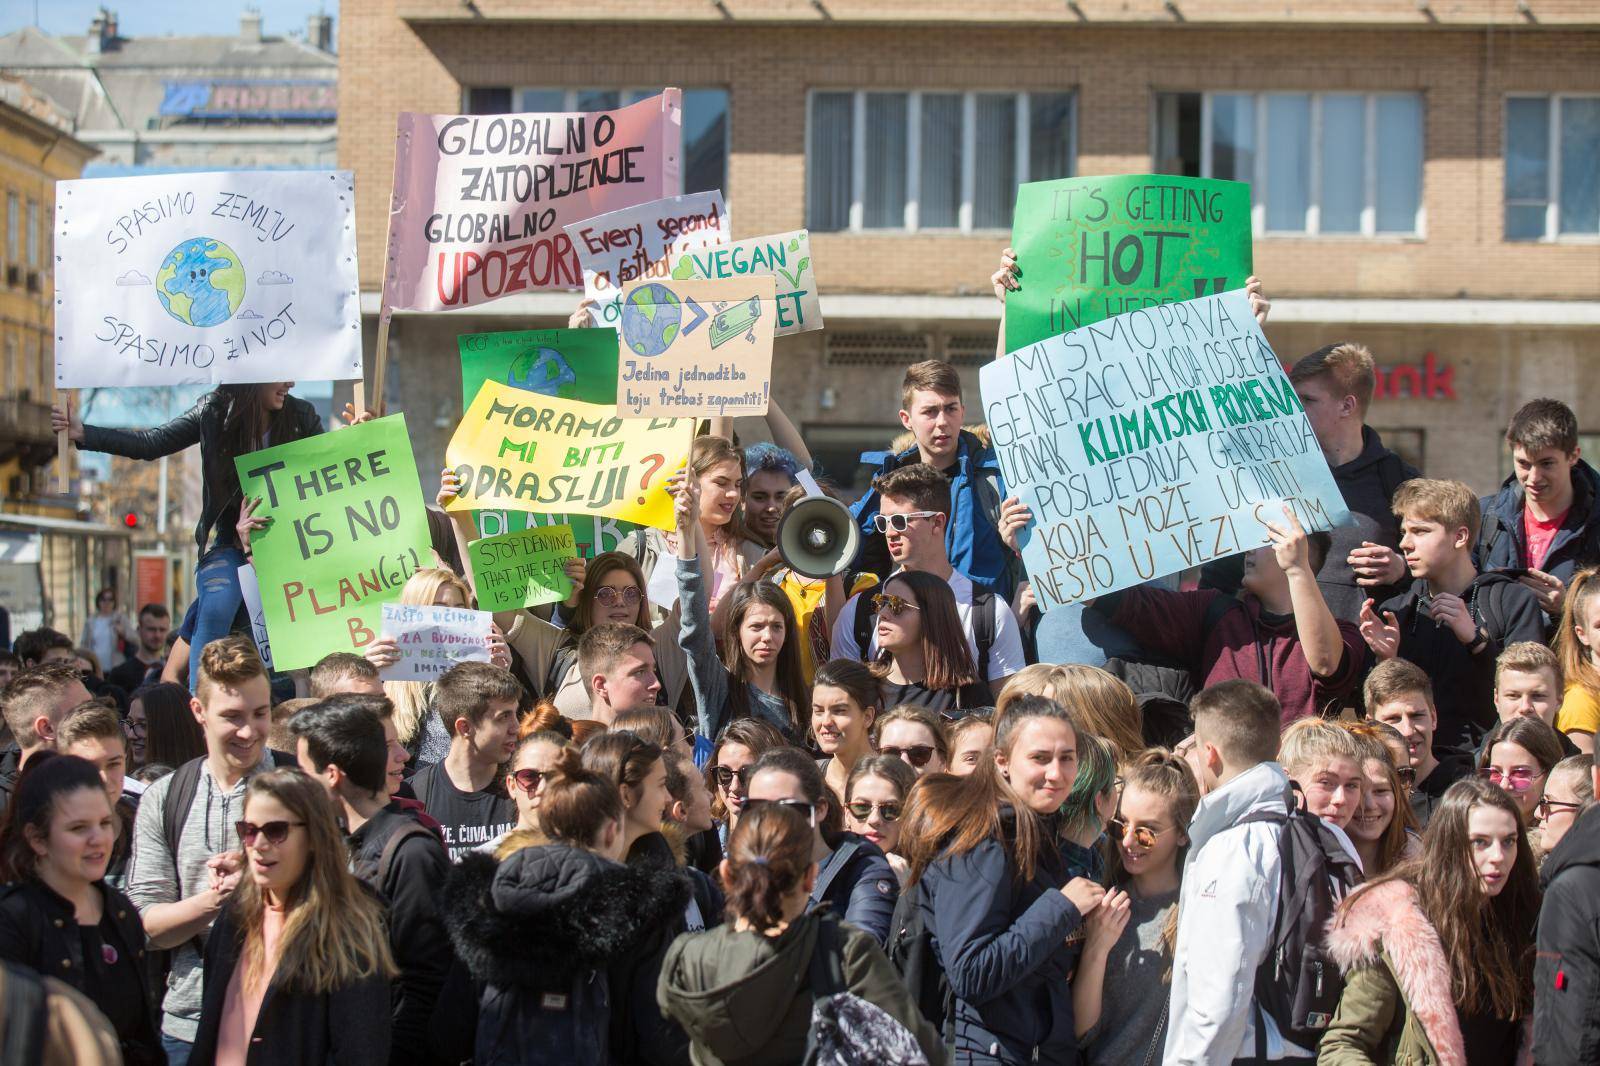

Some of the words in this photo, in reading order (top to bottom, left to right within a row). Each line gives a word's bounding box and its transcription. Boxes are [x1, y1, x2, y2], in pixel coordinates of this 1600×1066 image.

[438, 115, 615, 156] GLOBALNO
[460, 146, 644, 203] ZATOPLJENJE
[106, 191, 195, 254] SPASIMO
[211, 191, 295, 243] ZEMLJU
[1051, 185, 1109, 222] IT'S
[1126, 185, 1223, 224] GETTING
[424, 208, 556, 244] GLOBALNO
[579, 223, 643, 255] Every
[657, 202, 721, 241] second
[692, 240, 786, 280] VEGAN
[1080, 231, 1190, 288] HOT
[1050, 298, 1081, 332] IN
[95, 316, 215, 369] SPASIMO
[223, 302, 296, 360] ŽIVOT
[1013, 342, 1056, 391] MI
[1063, 309, 1157, 372] SMO
[1158, 298, 1238, 343] PRVA
[623, 360, 670, 382] Jedina
[673, 362, 746, 392] jednadžba
[659, 387, 704, 407] trebaš
[988, 352, 1171, 446] GENERACIJA
[485, 398, 623, 438] MORAMO
[498, 436, 538, 464] MI
[563, 441, 625, 468] BITI
[1034, 441, 1198, 523] POSLJEDNJA
[1208, 414, 1320, 469] GENERACIJA
[247, 450, 390, 508] THERE
[293, 512, 334, 560] IS
[345, 495, 400, 541] NO
[1037, 514, 1107, 566] KOJA
[1117, 481, 1199, 542] MOŽE
[480, 538, 520, 565] STOP
[522, 533, 573, 555] DENYING
[1033, 552, 1114, 611] NEŠTO
[1128, 540, 1155, 580] U
[1171, 514, 1241, 567] VEZI
[283, 548, 420, 622] PLAN(et)
[480, 568, 512, 590] THAT
[516, 562, 540, 581] THE
[493, 591, 509, 604] IS
[347, 617, 376, 648] B
[402, 632, 422, 644] ZA
[458, 824, 494, 843] ČUVAJ
